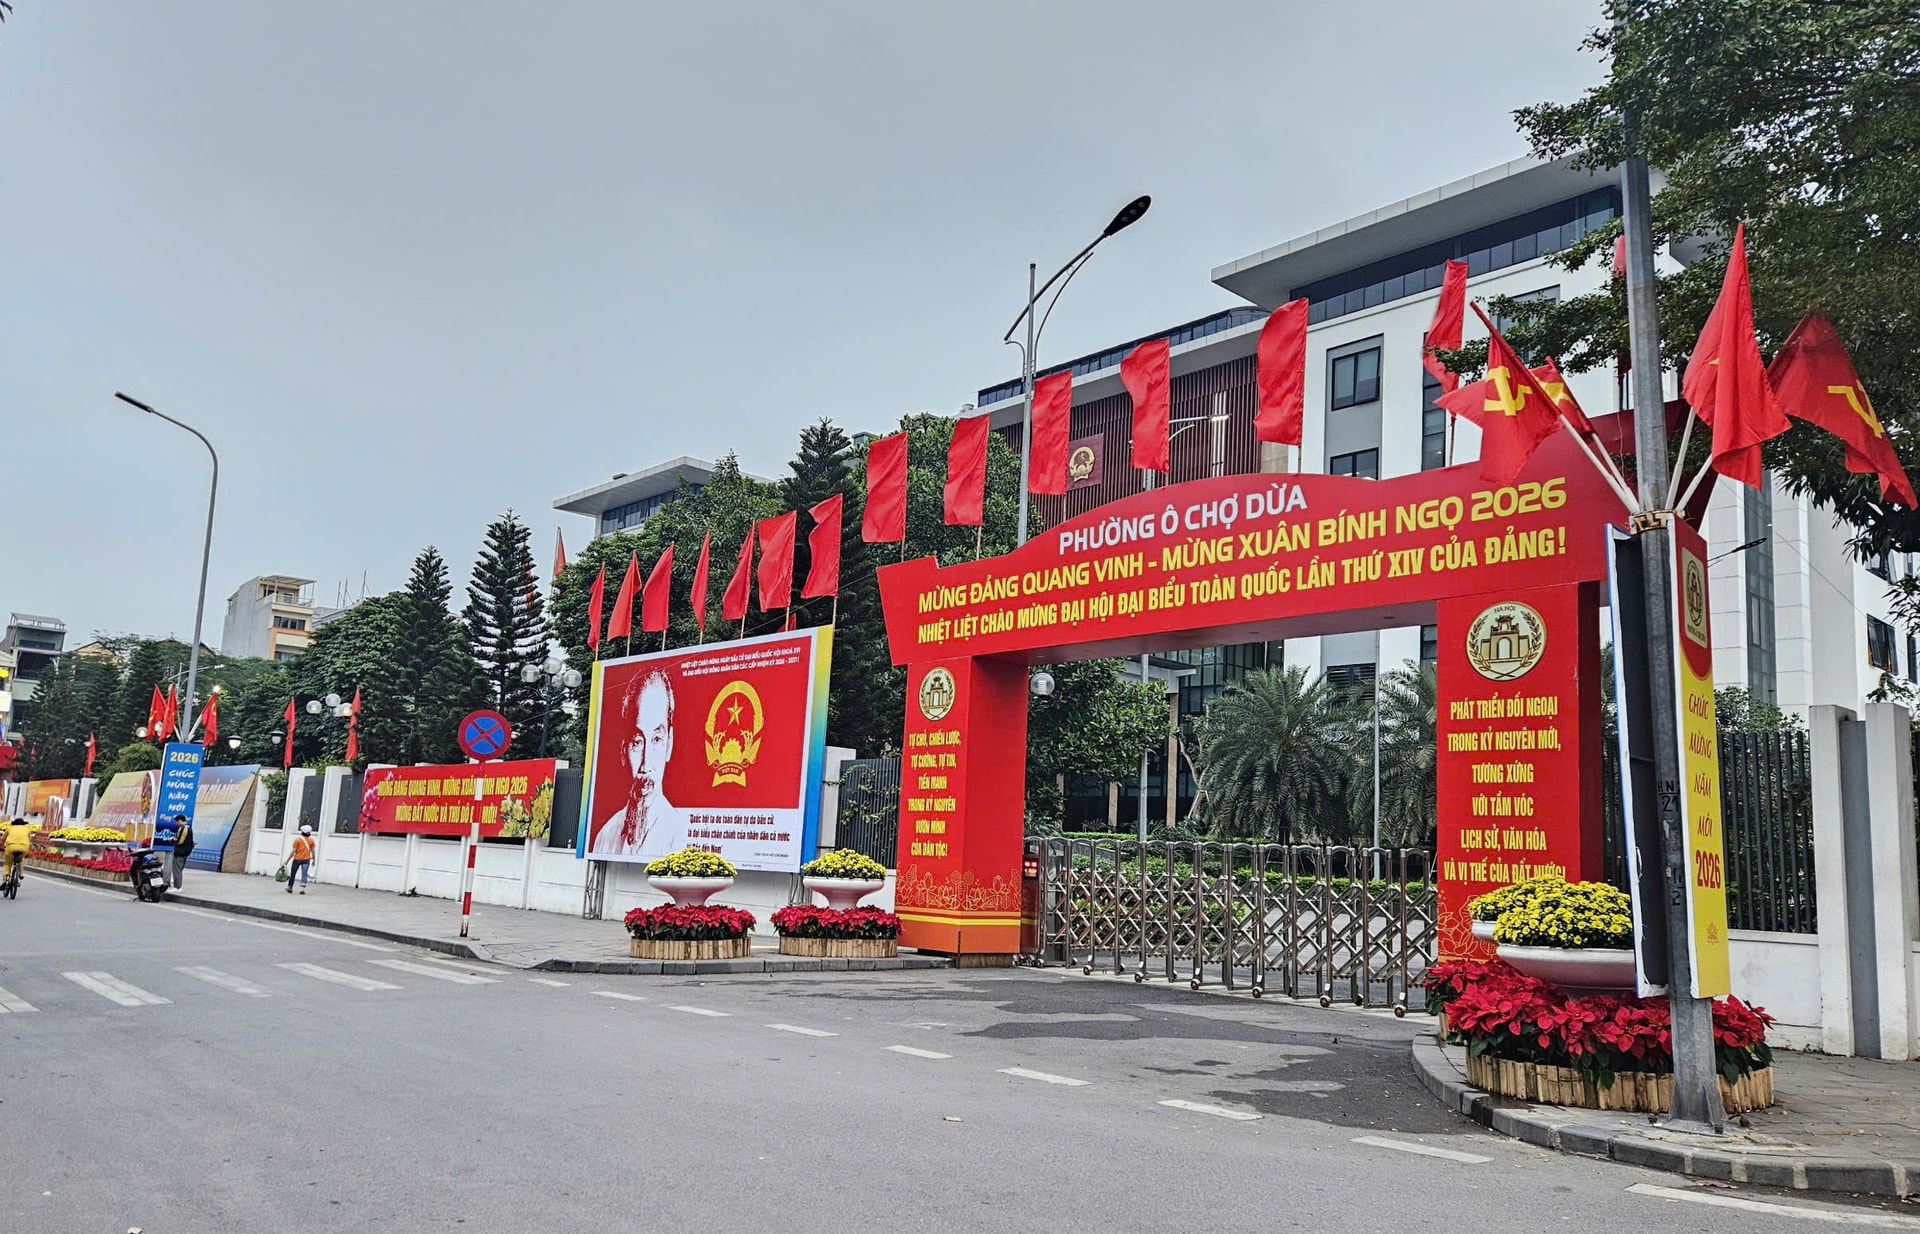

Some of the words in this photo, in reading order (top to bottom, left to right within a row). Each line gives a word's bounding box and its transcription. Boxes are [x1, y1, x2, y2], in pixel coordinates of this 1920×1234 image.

[1059, 514, 1155, 555] PHƯỜNG
[1160, 503, 1179, 534] Ô
[1184, 493, 1239, 530] CHỢ
[1246, 482, 1308, 519] DỪA
[918, 585, 967, 614] MỪNG
[969, 574, 1019, 604] ĐẢNG
[1022, 562, 1090, 595] QUANG
[1093, 552, 1143, 582] VINH
[1162, 536, 1234, 572] MỪNG
[1238, 520, 1311, 559] XUÂN
[1318, 508, 1387, 547] BÍNH
[1395, 496, 1464, 534] NGỌ
[1470, 476, 1567, 522] 2026
[918, 618, 951, 645] NHIỆT
[954, 613, 979, 641] LIỆT
[980, 608, 1014, 635] CHÀO
[1017, 602, 1057, 629] MỪNG
[1061, 600, 1084, 626] ĐẠI
[1089, 591, 1114, 622] HỘI
[1117, 589, 1143, 618] ĐẠI
[1148, 576, 1186, 610] BIỂU
[1190, 573, 1236, 604] TOÀN
[1240, 561, 1291, 600] QUỐC
[1296, 554, 1336, 590] LẦN
[1341, 549, 1384, 584] THỨ
[1387, 547, 1425, 578] XIV
[1430, 535, 1478, 572] CỦA
[1484, 525, 1566, 565] ĐẢNG!
[1450, 697, 1475, 720] PHÁT
[1476, 691, 1504, 719] TRIỂN
[1506, 694, 1524, 717] ĐỐI
[1526, 696, 1558, 720] NGOẠI
[1688, 693, 1709, 720] CHÚC
[1447, 732, 1479, 752] TRONG
[1480, 725, 1493, 750] KỶ
[1495, 727, 1535, 750] NGUYÊN
[1538, 725, 1561, 751] MỚI,
[1689, 729, 1712, 759] MỪNG
[169, 751, 199, 764] 2026
[166, 780, 194, 790] MỪNG
[168, 768, 196, 778] CHÚC
[1472, 763, 1504, 784] TƯƠNG
[1506, 760, 1534, 783] XỨNG
[1694, 771, 1712, 799] NĂM
[167, 792, 189, 801] NĂM
[167, 803, 186, 812] MỚI
[1472, 793, 1488, 816] VỚI
[1490, 790, 1512, 816] TẦM
[1514, 793, 1534, 817] VÓC
[1697, 811, 1713, 837] MỚI
[1461, 829, 1483, 852] LỊCH
[1484, 824, 1501, 851] SỬ,
[1502, 826, 1523, 850] VĂN
[1525, 827, 1547, 851] HÓA
[1443, 857, 1456, 880] VÀ
[1458, 862, 1468, 886] VỊ
[1469, 856, 1487, 882] THẾ
[1489, 856, 1510, 882] CỦA
[1695, 849, 1721, 890] 2026
